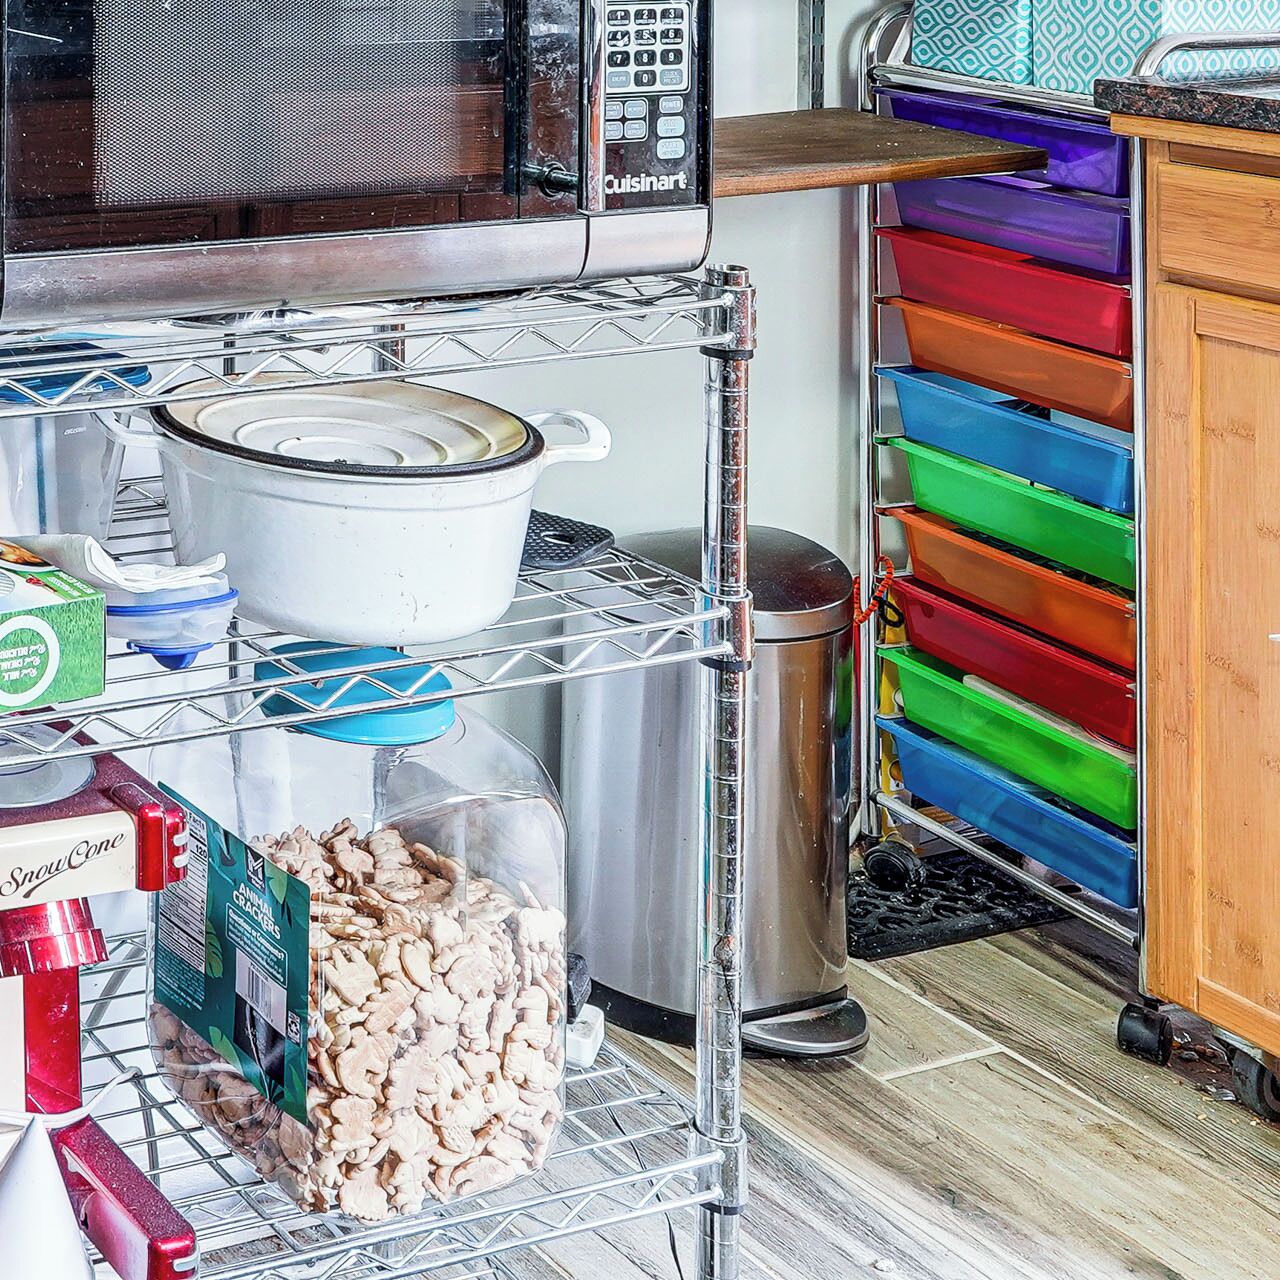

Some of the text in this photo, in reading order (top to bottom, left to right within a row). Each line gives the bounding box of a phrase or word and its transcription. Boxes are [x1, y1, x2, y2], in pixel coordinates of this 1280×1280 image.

[642, 10, 648, 18] 2
[669, 9, 674, 18] 3
[669, 29, 674, 38] 6
[616, 52, 674, 63] 7 8 9
[642, 73, 648, 82] 0
[605, 170, 687, 194] Cuisinart
[196, 844, 207, 858] 120
[239, 883, 274, 919] ANIMAL
[232, 889, 280, 941] CRACKERS
